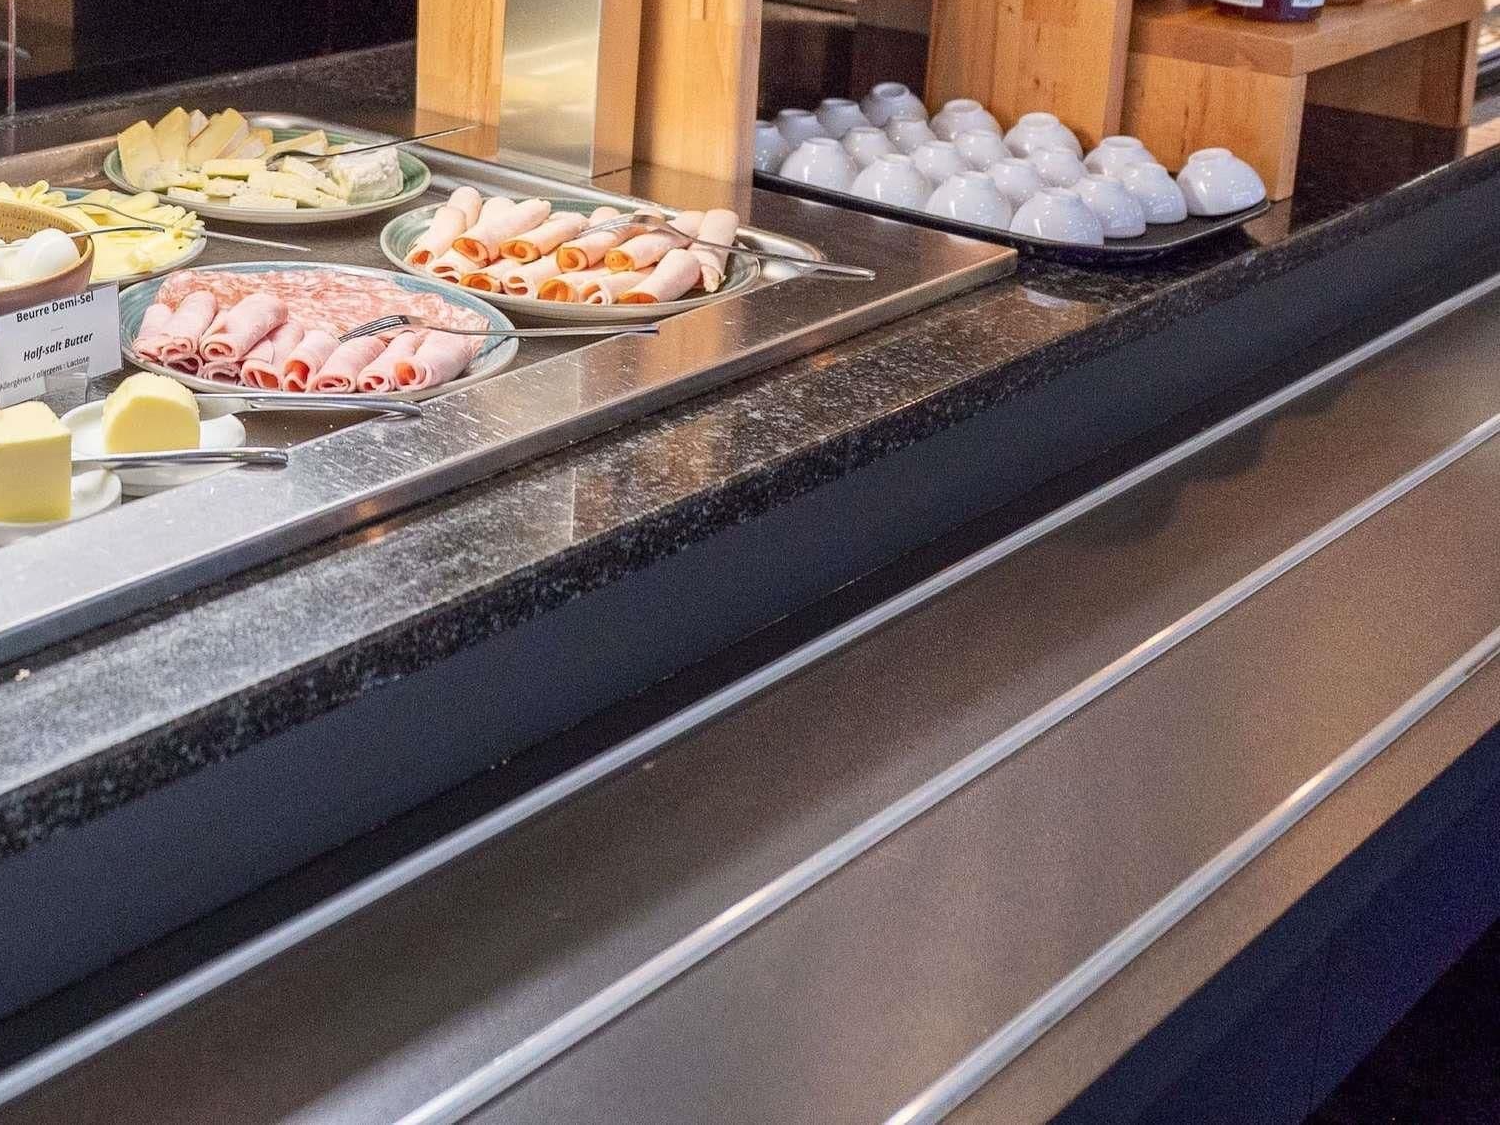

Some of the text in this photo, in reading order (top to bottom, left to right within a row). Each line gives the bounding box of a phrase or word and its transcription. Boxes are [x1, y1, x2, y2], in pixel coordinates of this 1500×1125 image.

[16, 290, 95, 322] Beurre Demi-Sel
[23, 332, 94, 361] Half-salt Butter
